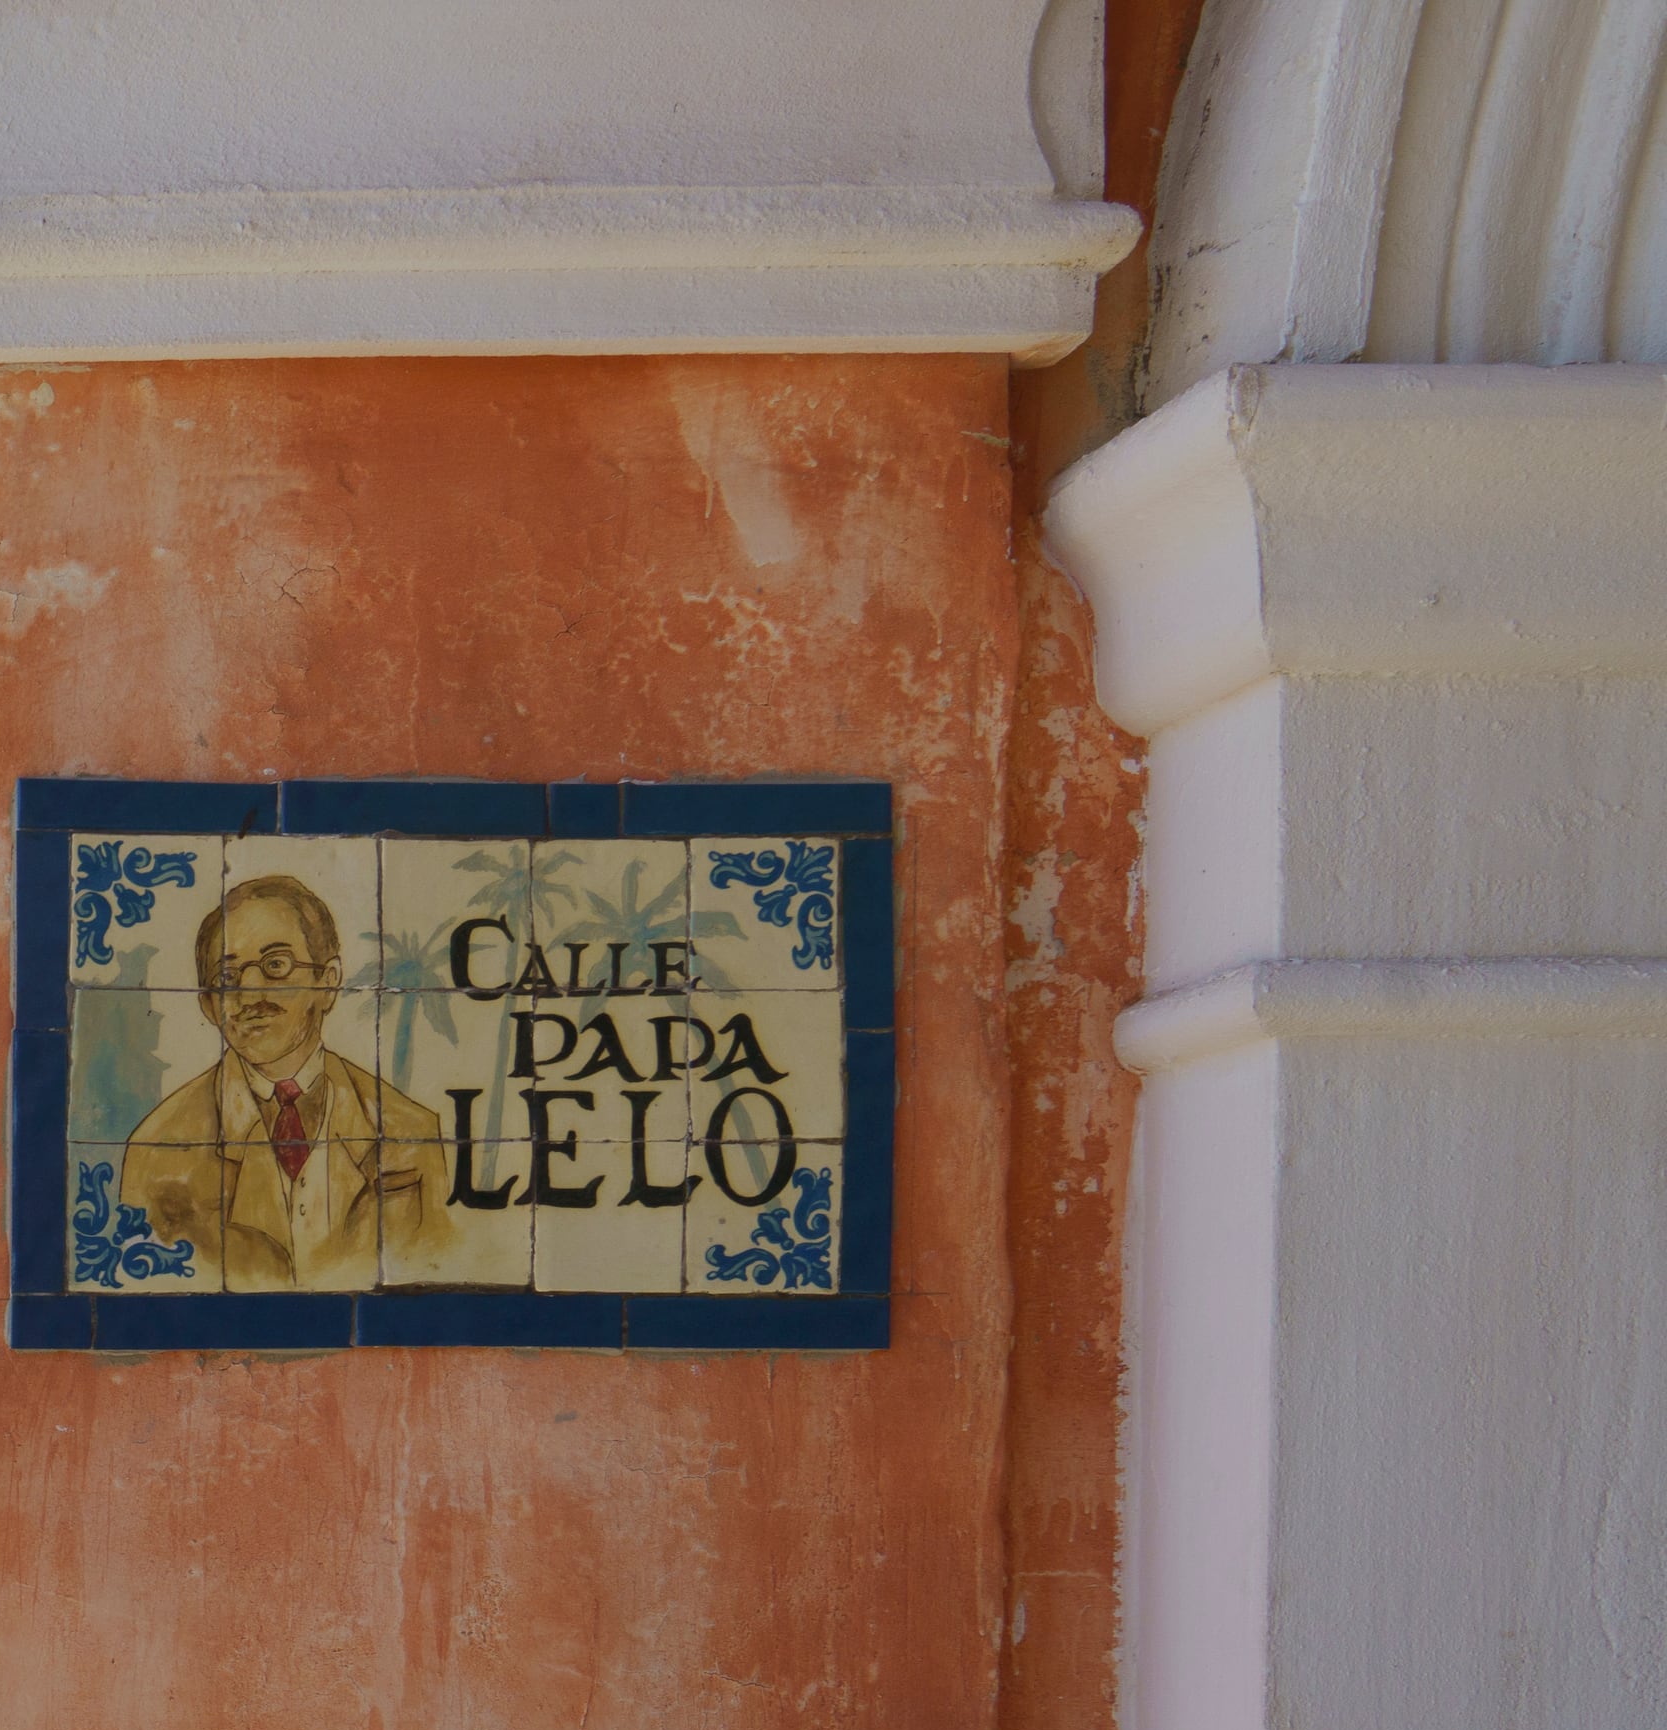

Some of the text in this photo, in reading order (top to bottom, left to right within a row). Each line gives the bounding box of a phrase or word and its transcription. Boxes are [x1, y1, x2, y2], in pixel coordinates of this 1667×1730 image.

[450, 914, 702, 1001] CALLE
[507, 1010, 789, 1084] PAPA
[445, 1087, 798, 1210] LELO
